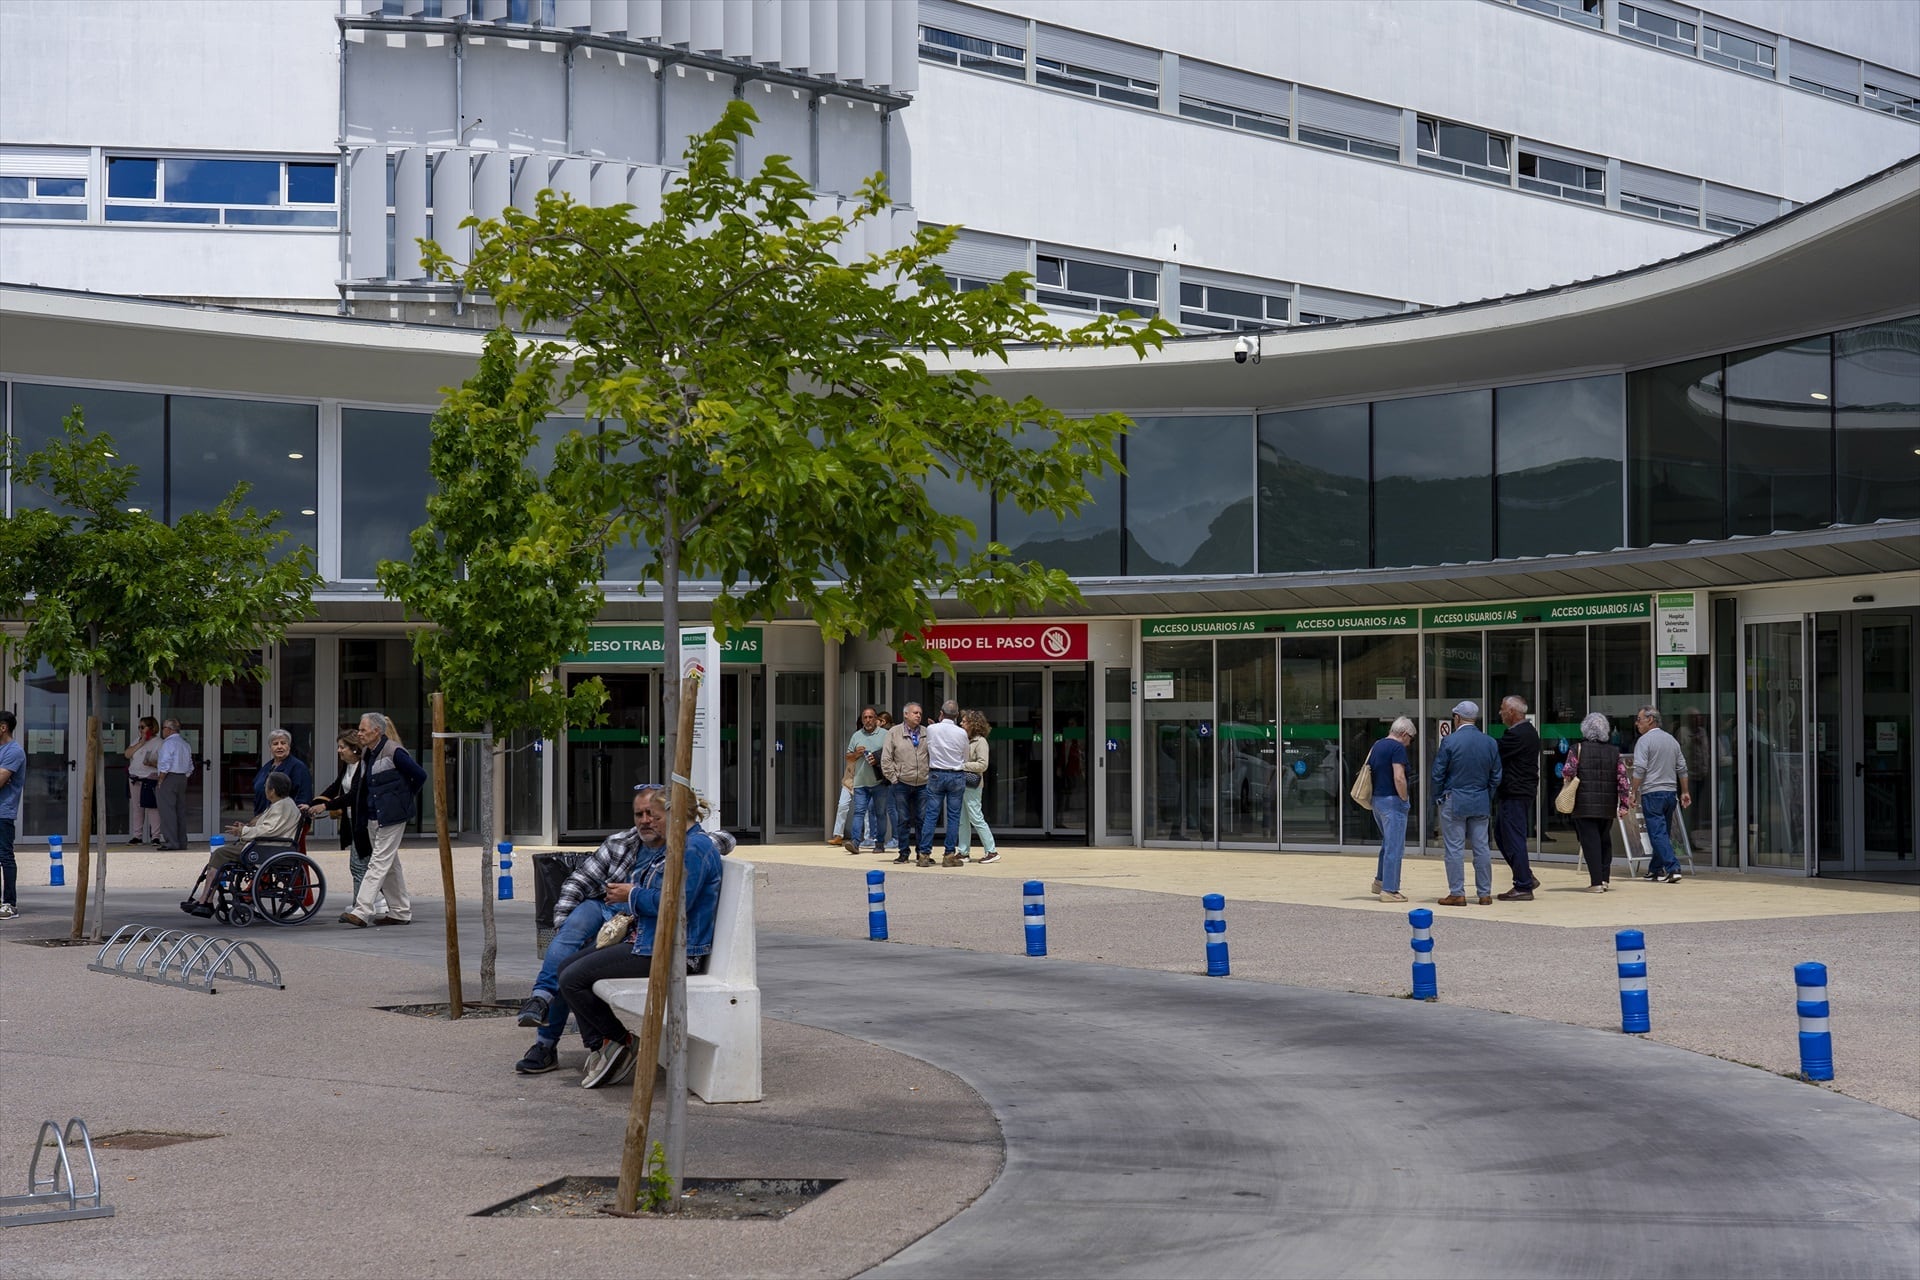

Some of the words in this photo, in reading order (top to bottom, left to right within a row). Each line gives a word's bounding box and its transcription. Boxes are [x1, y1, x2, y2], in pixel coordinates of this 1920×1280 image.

[1551, 606, 1584, 617] ACCESO
[1585, 603, 1628, 615] USUARIOS
[1632, 602, 1645, 612] AS
[1296, 619, 1335, 629] ACCESO
[1337, 617, 1387, 628] USUARIOS
[1392, 616, 1407, 626] AS
[1433, 614, 1463, 624] ACCESO
[1464, 611, 1502, 622] USUARIOS
[1506, 610, 1517, 620] AS
[1152, 624, 1189, 633] ACCESO
[1191, 622, 1237, 632] USUARIOS
[1242, 621, 1255, 631] AS
[740, 640, 758, 651] AS
[976, 637, 993, 649] EL
[996, 637, 1035, 649] PASO
